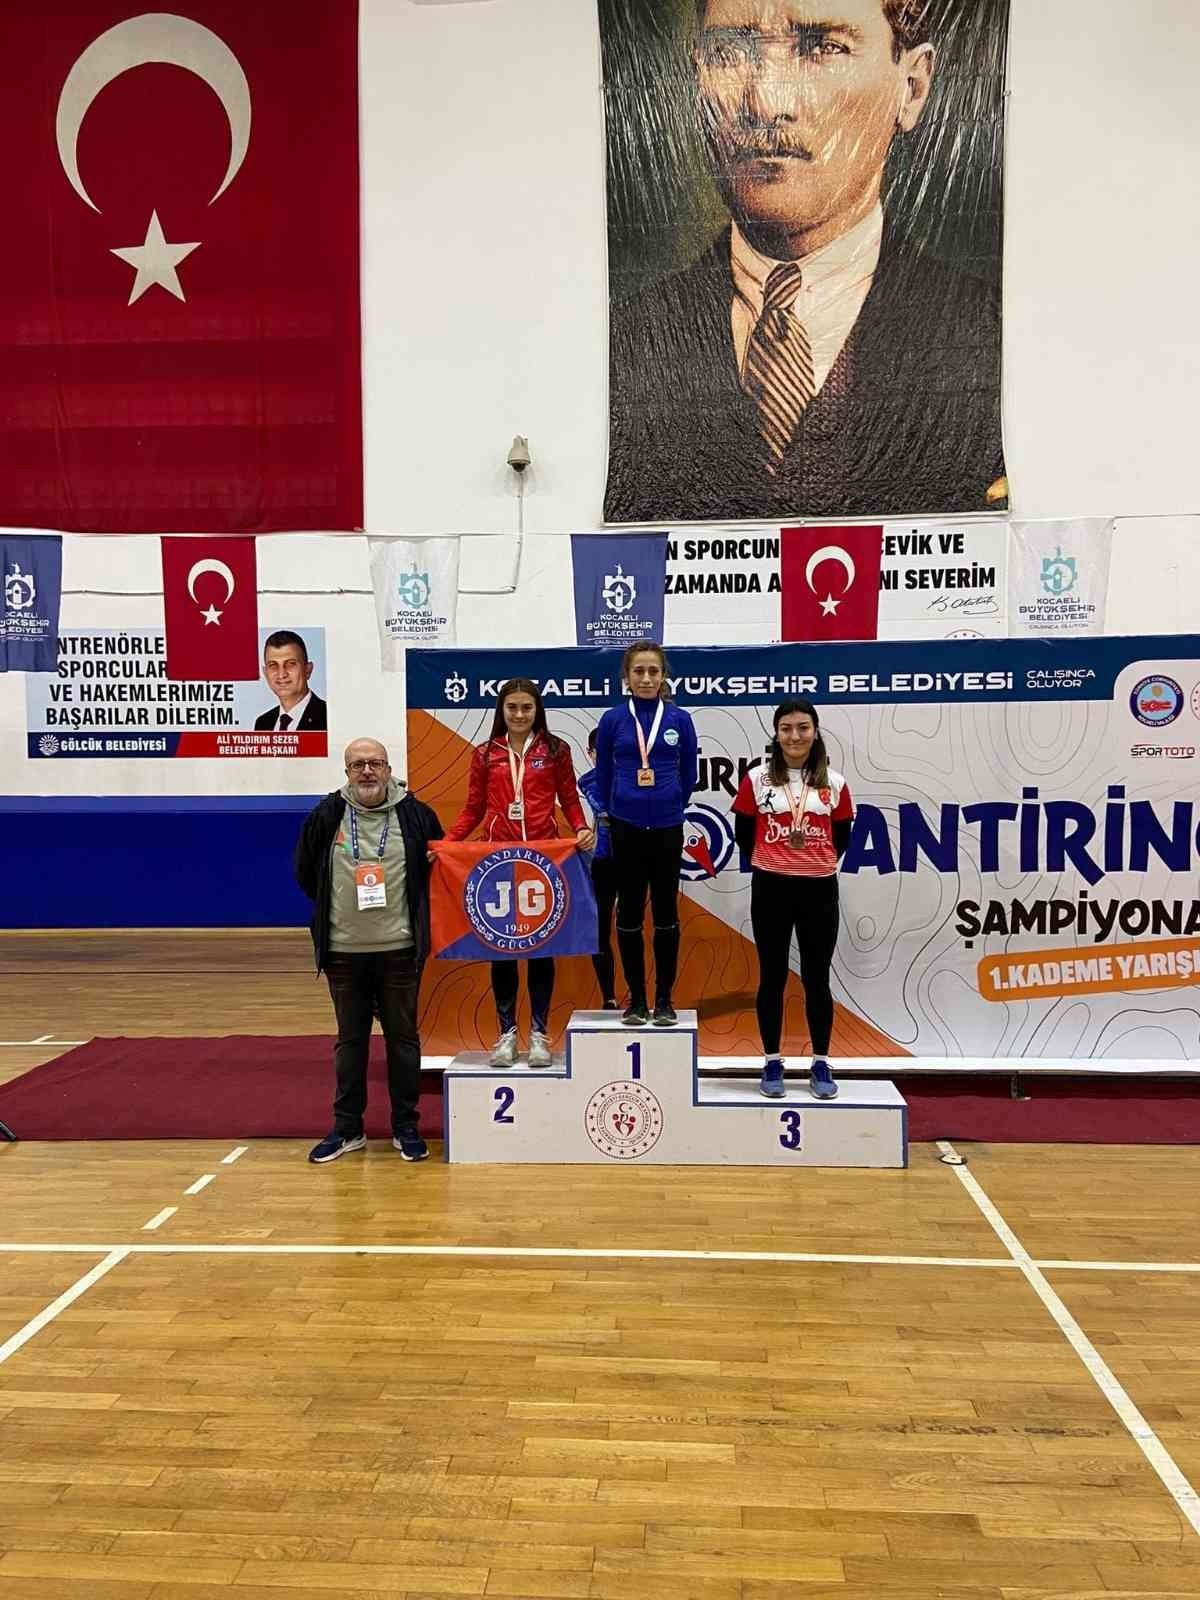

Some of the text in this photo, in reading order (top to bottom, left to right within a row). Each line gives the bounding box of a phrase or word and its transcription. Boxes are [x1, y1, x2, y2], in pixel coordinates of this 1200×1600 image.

[881, 529, 964, 556] EVİK VE
[664, 573, 762, 594] ZAMANDA
[905, 562, 995, 589] SEVERİM
[49, 680, 234, 702] VE HAKEMLERİMİZE
[479, 672, 1014, 698] KAELİ YÜKŞEHİR BELEDİYESİ
[1026, 679, 1082, 688] OLUYOR
[46, 704, 240, 731] BAŞARILAR DİLERİM.
[60, 736, 166, 752] GÖLCÜK BELEDİYESİ
[216, 735, 299, 745] ALİ YILDIRIM SEZER
[219, 745, 297, 757] BELEDİYE BAŞKANI
[476, 849, 552, 875] JANDARMA
[504, 923, 530, 934] 1949
[497, 936, 536, 949] GÜCÜ
[989, 957, 1113, 990] 1.KADEME
[626, 1042, 641, 1079] 1
[493, 1086, 514, 1124] 2
[779, 1111, 801, 1150] 3
